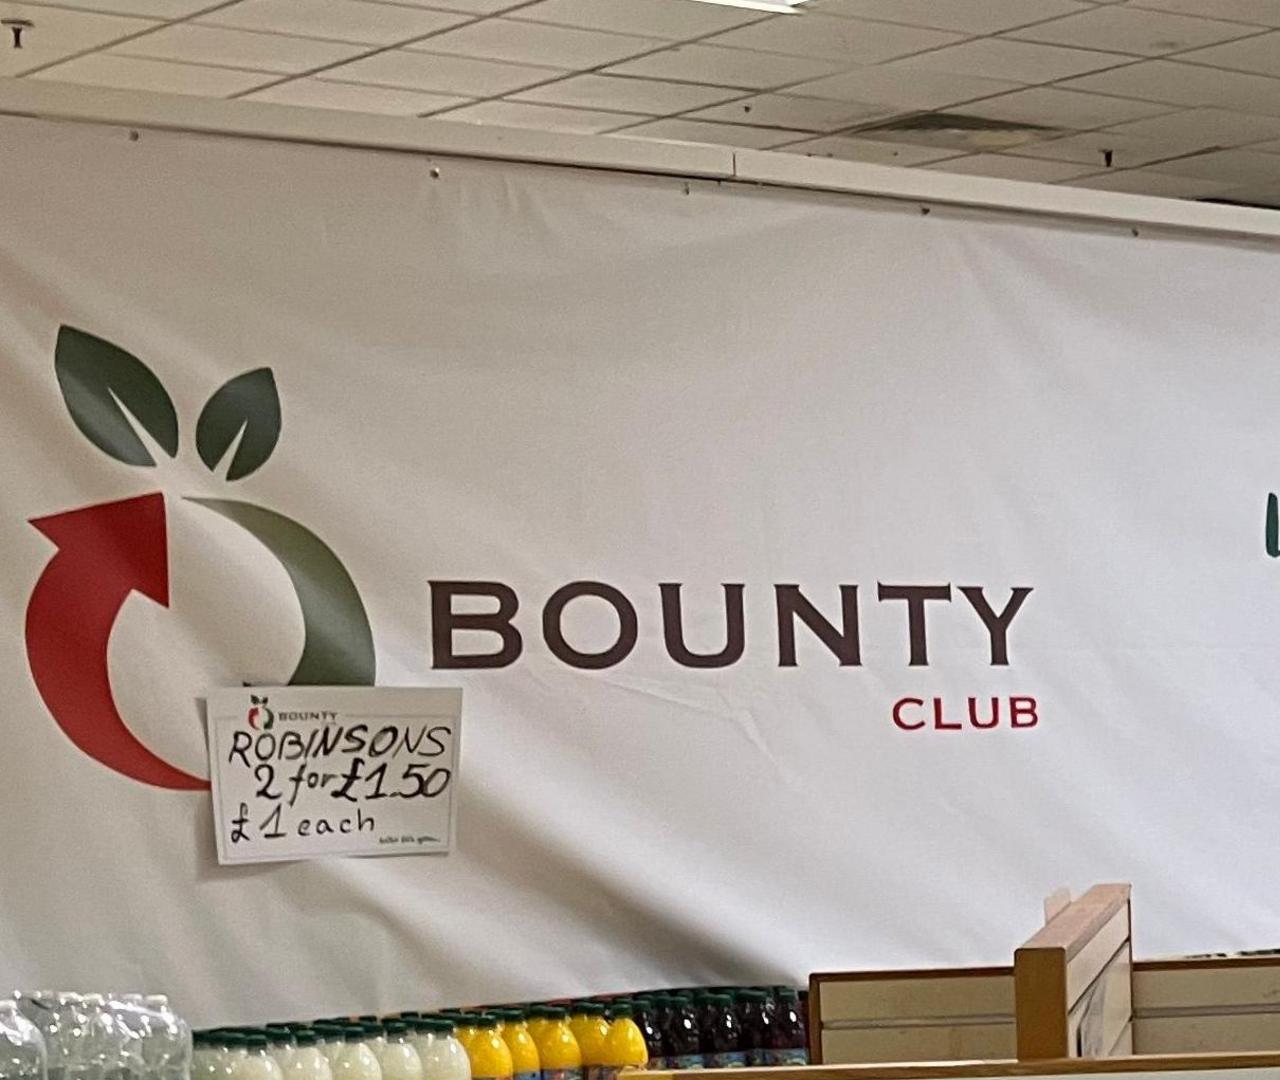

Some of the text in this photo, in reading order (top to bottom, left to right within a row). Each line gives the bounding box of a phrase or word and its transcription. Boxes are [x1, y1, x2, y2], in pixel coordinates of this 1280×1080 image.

[427, 579, 1033, 671] BOUNTY
[278, 711, 339, 722] BOUNTY
[892, 694, 1040, 731] CLUB
[228, 724, 451, 767] ROBINSONS
[254, 758, 451, 806] 2 for £1.50
[297, 808, 376, 836] each
